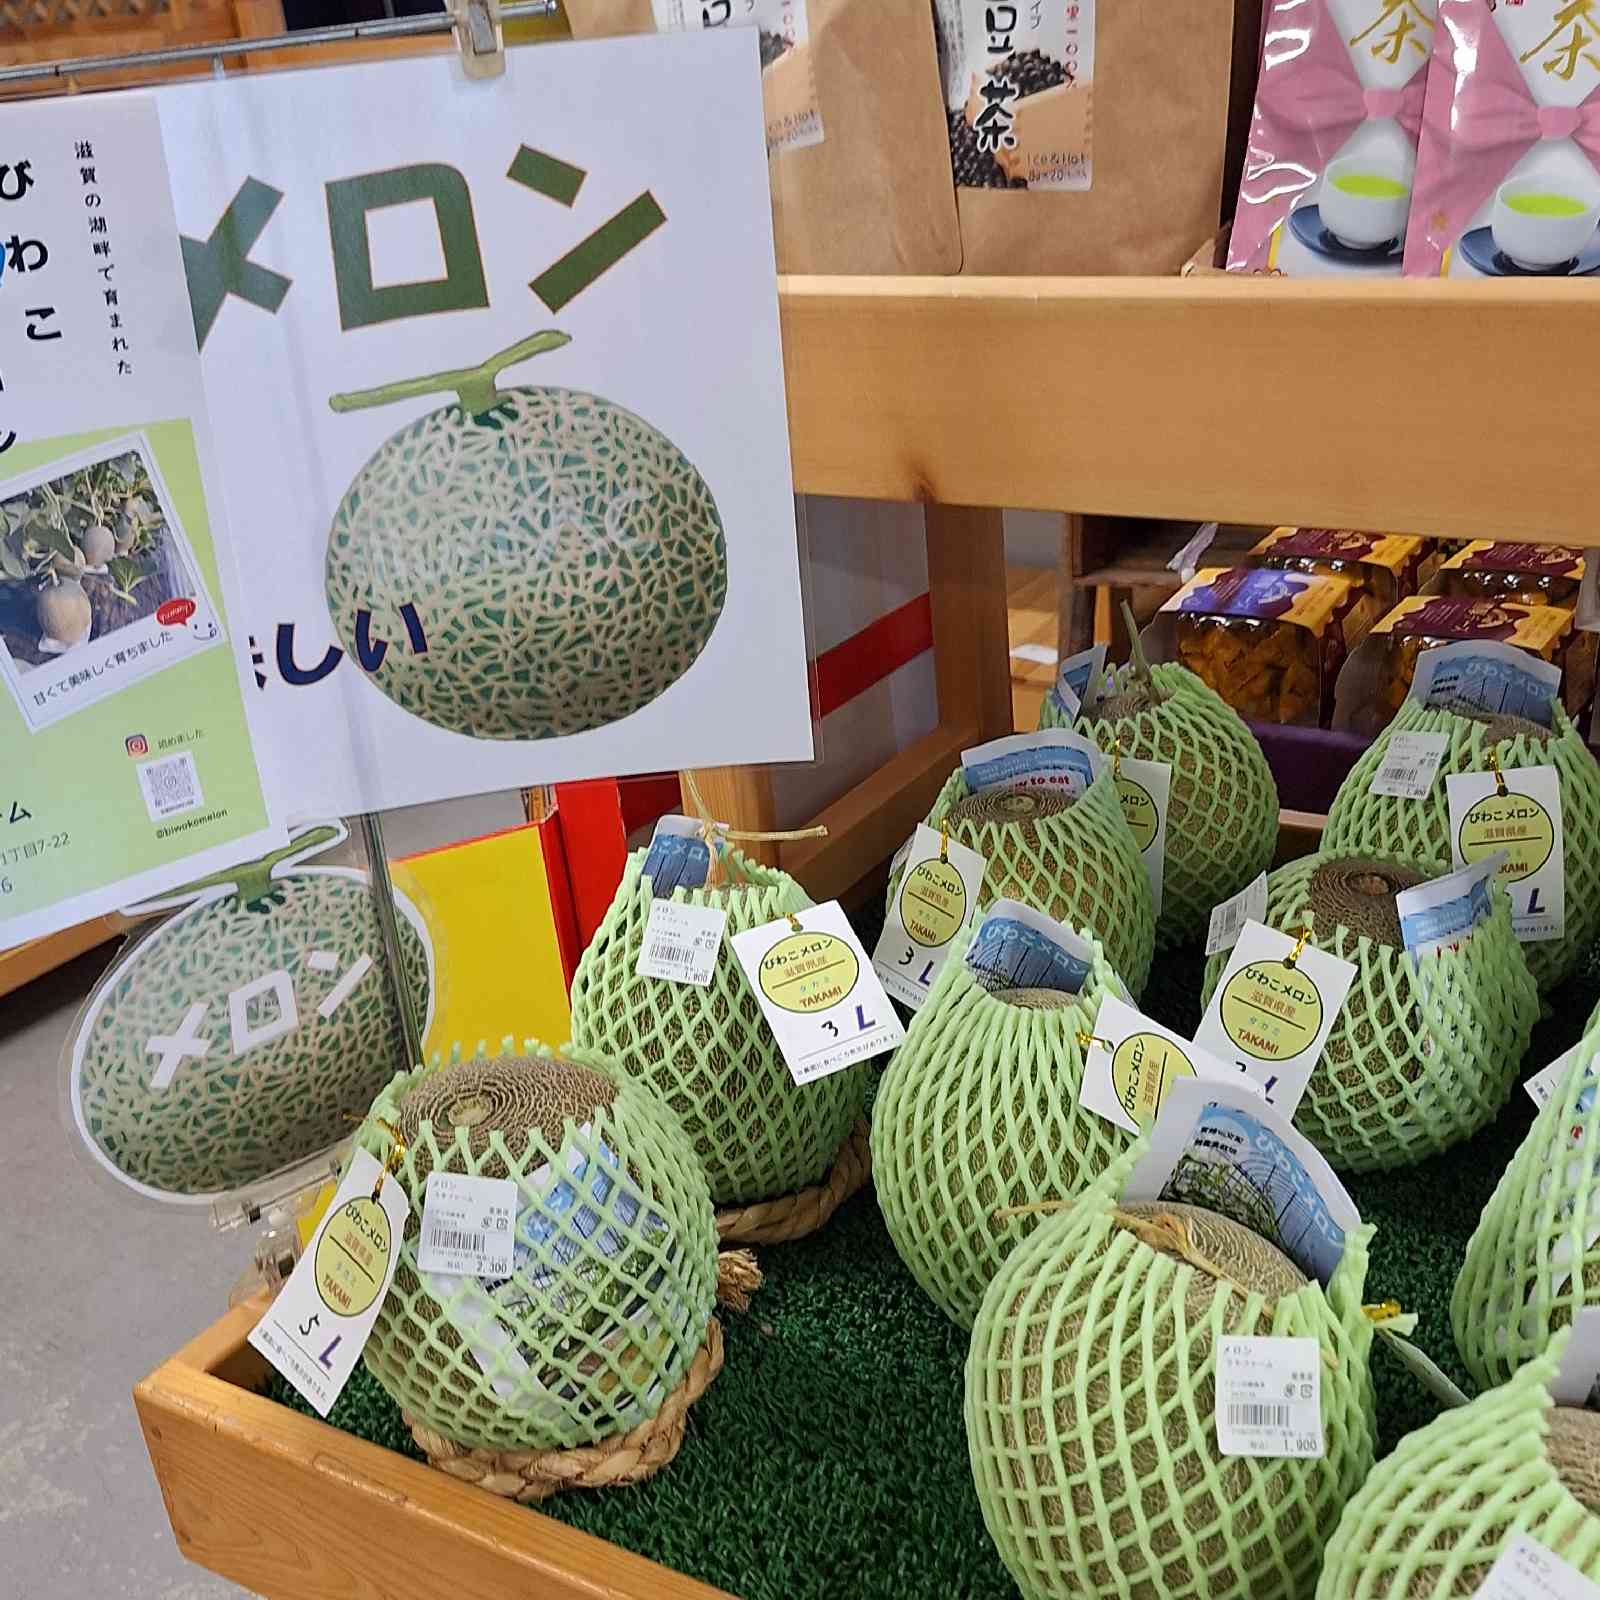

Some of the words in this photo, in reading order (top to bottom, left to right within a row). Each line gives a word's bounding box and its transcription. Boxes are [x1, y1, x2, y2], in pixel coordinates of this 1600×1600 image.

[74, 139, 132, 376] 滋賀の湖畔で育まれた
[179, 143, 667, 353] メロン
[249, 602, 428, 690] しい
[33, 630, 174, 707] 甘くて美味しく育ちました
[0, 800, 32, 824] ム
[1468, 806, 1540, 826] びわこメロン
[916, 865, 964, 898] びわこメロン
[1528, 887, 1545, 914] L
[763, 936, 834, 971] びわこメロン
[898, 945, 915, 966] 3
[919, 959, 936, 987] L
[799, 985, 843, 1009] TAKAMI
[1243, 965, 1318, 1007] びわこメロン
[145, 950, 373, 1089] メロン
[822, 1019, 839, 1038] 3
[855, 1004, 876, 1031] L
[1236, 1027, 1280, 1056] TAKAMI
[1126, 1037, 1146, 1112] びわこメロン
[344, 1203, 389, 1253] びわこメロン
[318, 1334, 343, 1370] L
